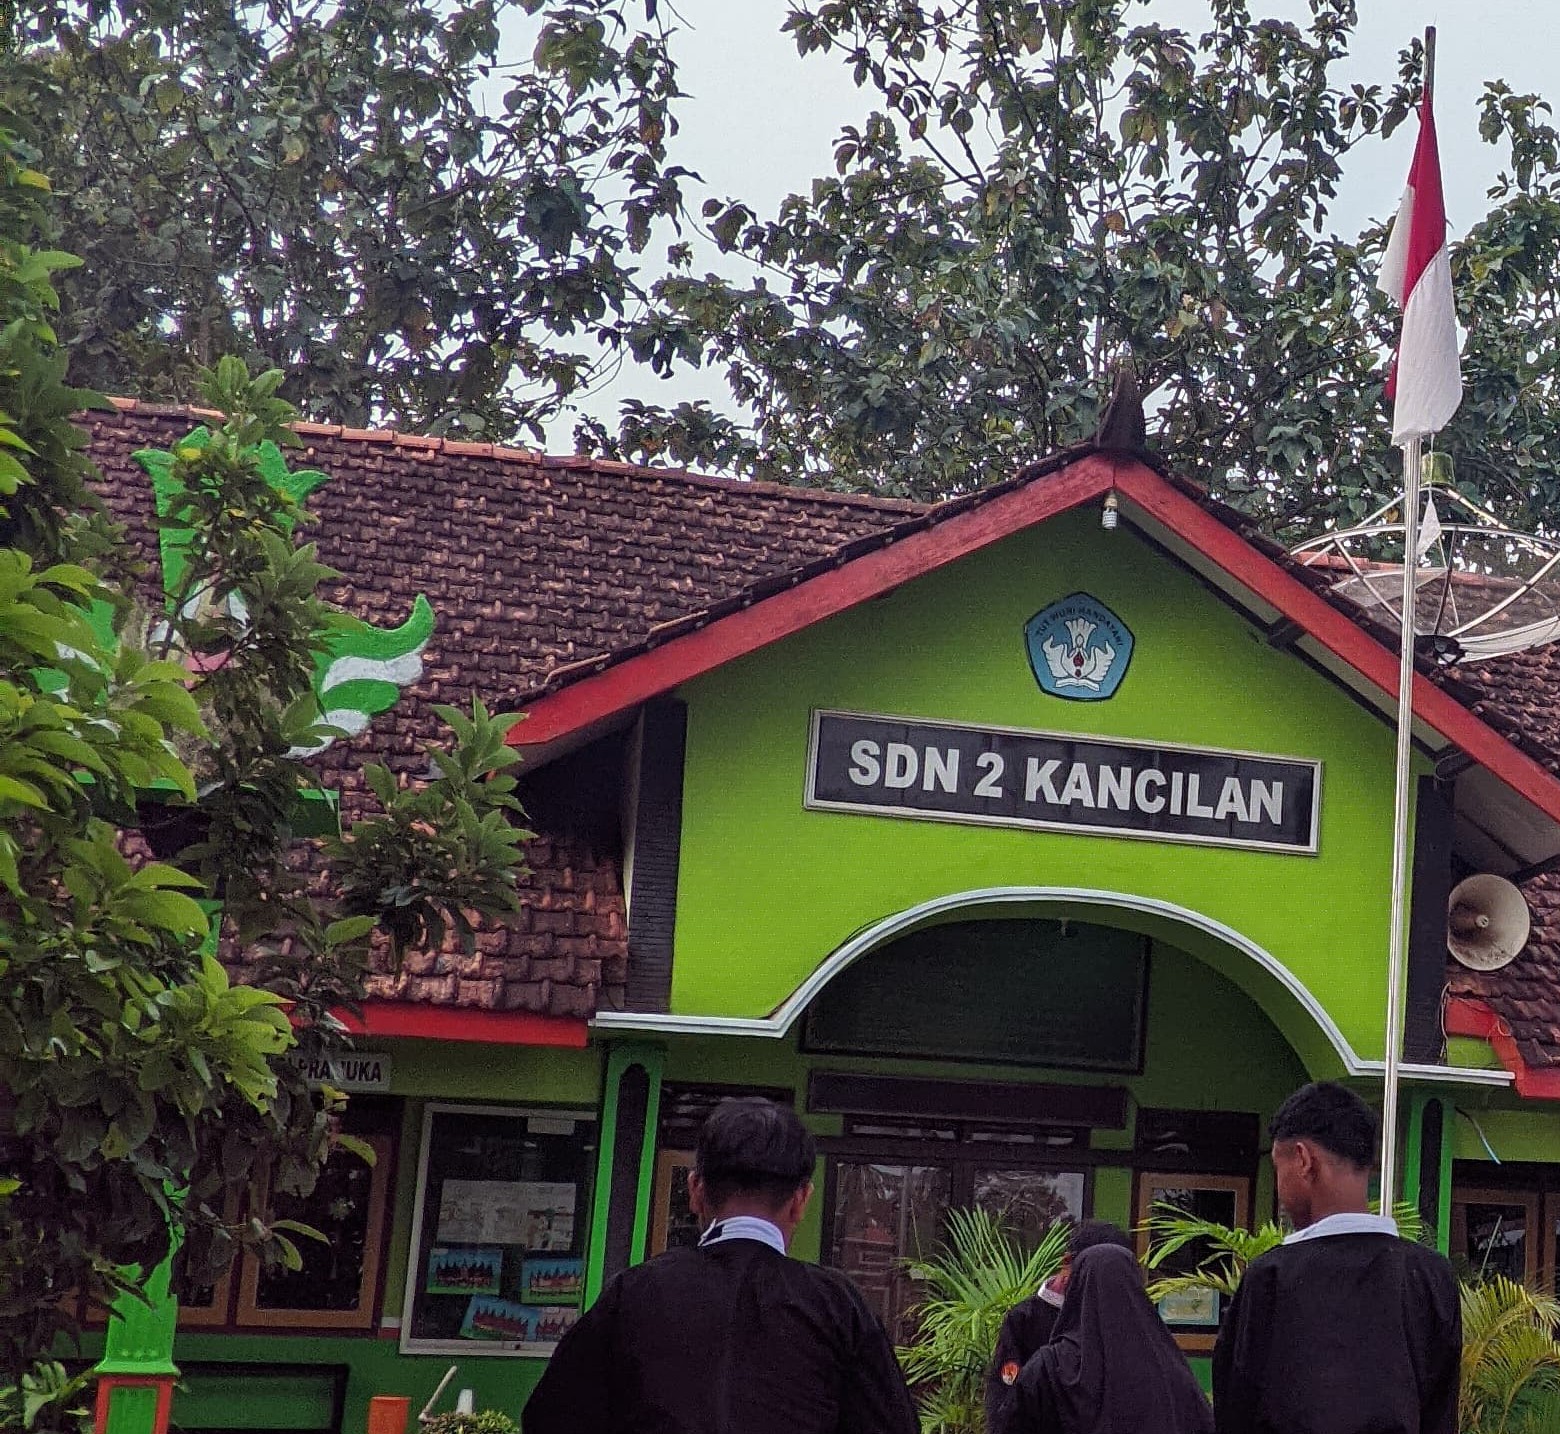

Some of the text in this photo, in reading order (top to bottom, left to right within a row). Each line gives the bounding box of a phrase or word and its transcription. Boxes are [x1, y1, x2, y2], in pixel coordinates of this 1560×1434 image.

[848, 739, 1285, 825] SDN 2 KANCILAN
